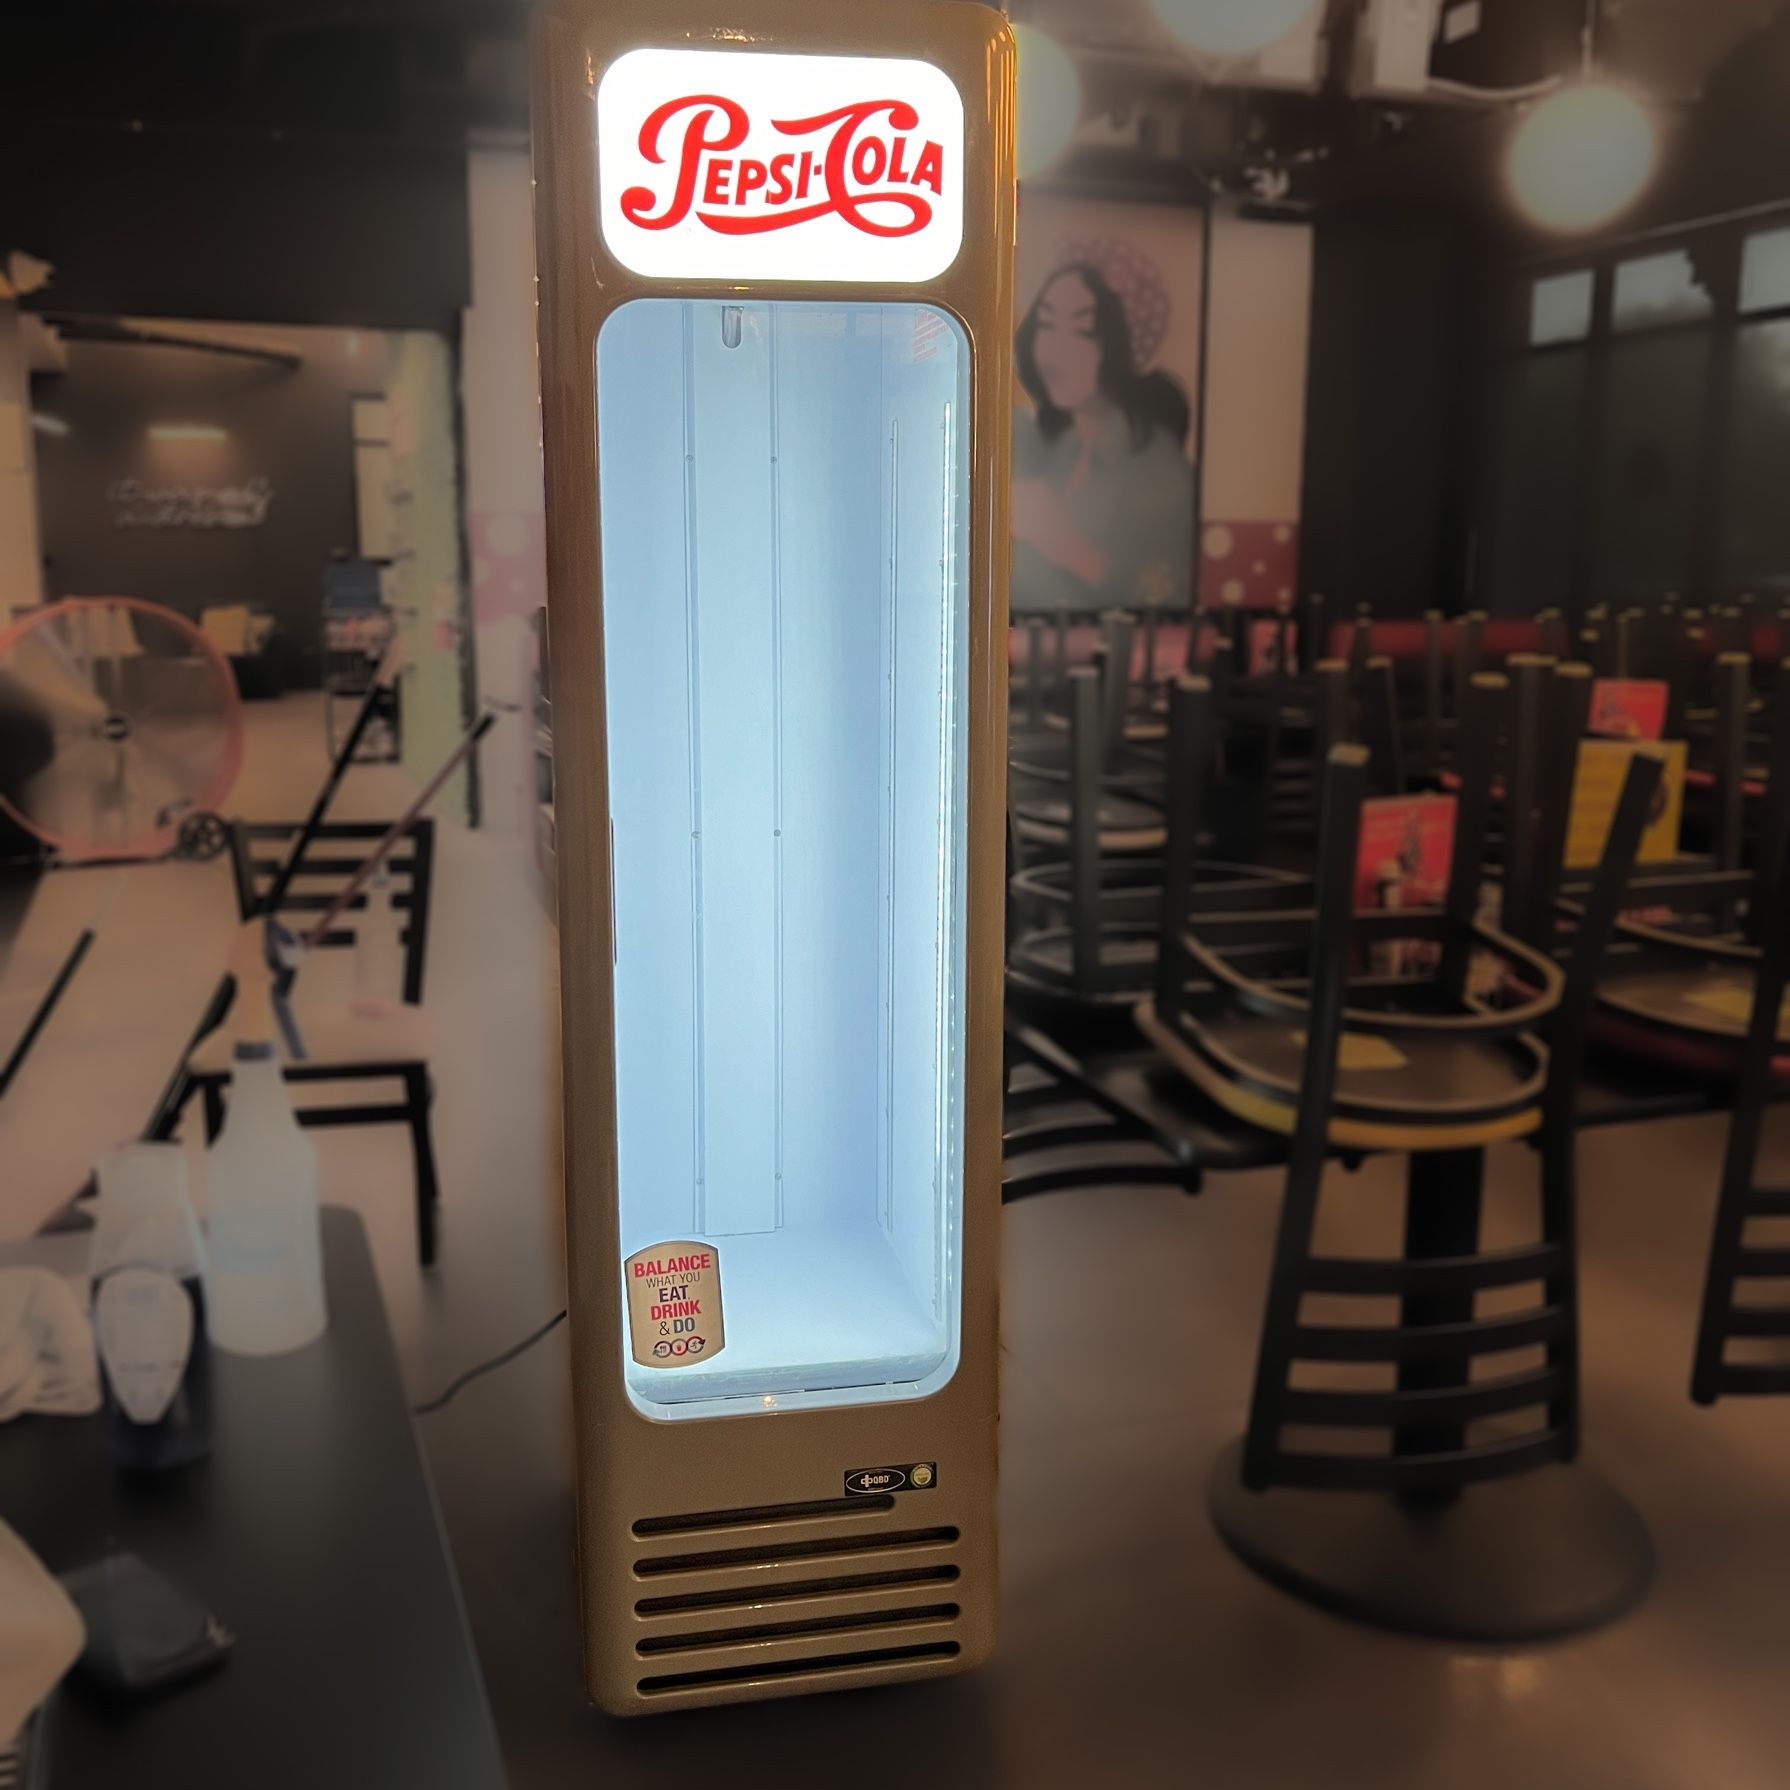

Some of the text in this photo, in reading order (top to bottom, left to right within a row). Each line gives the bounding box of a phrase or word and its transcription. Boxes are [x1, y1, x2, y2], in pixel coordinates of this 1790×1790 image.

[633, 1253, 711, 1278] BALANCE
[645, 1272, 700, 1288] WHAT YOU
[650, 1300, 701, 1320] DRINK
[659, 1317, 696, 1336] & DO
